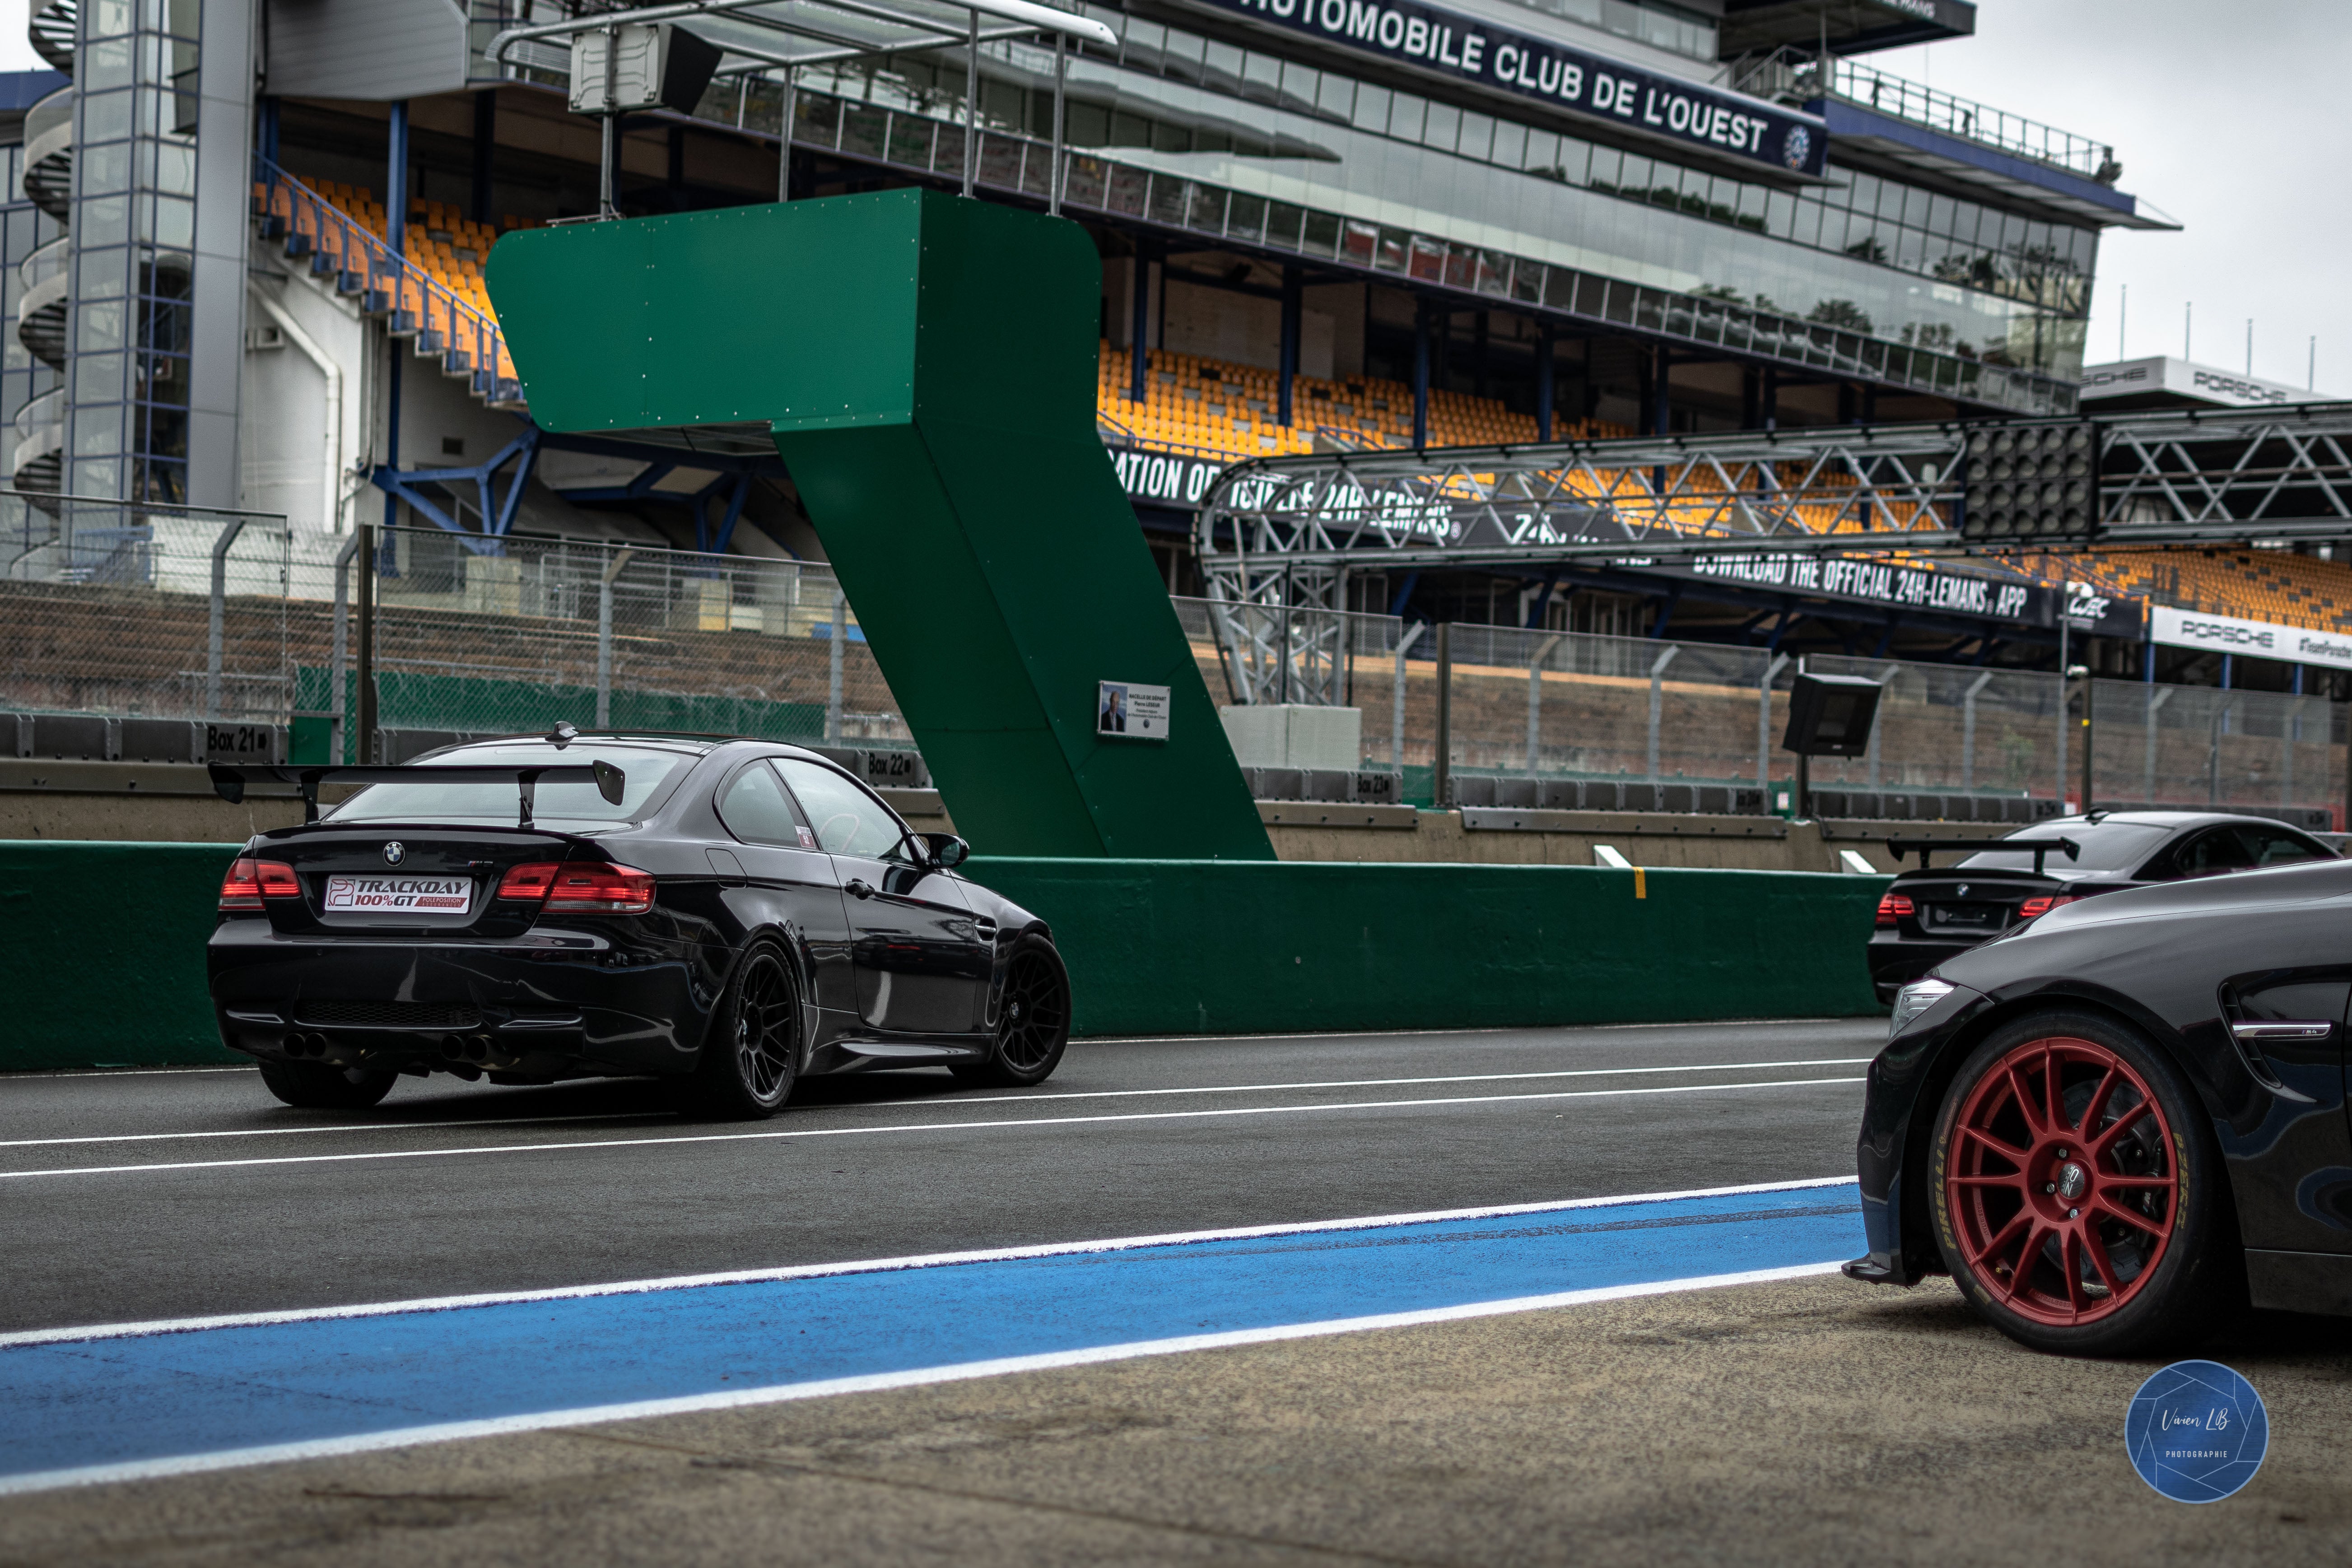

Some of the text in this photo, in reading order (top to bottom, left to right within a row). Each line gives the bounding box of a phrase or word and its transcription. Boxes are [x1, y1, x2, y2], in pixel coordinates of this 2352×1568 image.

[1242, 0, 1486, 73] UTOMOBILE
[1494, 44, 1583, 100] CLUB
[1592, 72, 1638, 116] DE
[1643, 89, 1768, 153] L'OUEST
[2080, 368, 2147, 387] SCHE
[2195, 371, 2287, 404] PORSCHE
[1108, 448, 1183, 500] ATION
[1791, 553, 1820, 589] THE
[1823, 560, 1892, 600] OFFICIAL
[1895, 569, 1989, 613] 24H-LEMANS
[1995, 584, 2028, 618] APP
[2068, 596, 2111, 619] WEC
[2182, 620, 2274, 648] PORSCHE
[208, 725, 255, 753] Box 21
[869, 753, 904, 776] Box 22
[1358, 774, 1371, 793] Box
[354, 894, 417, 907] 100%GT
[358, 880, 469, 894] TRACKDAY
[1935, 1148, 1956, 1249] PIRELLI
